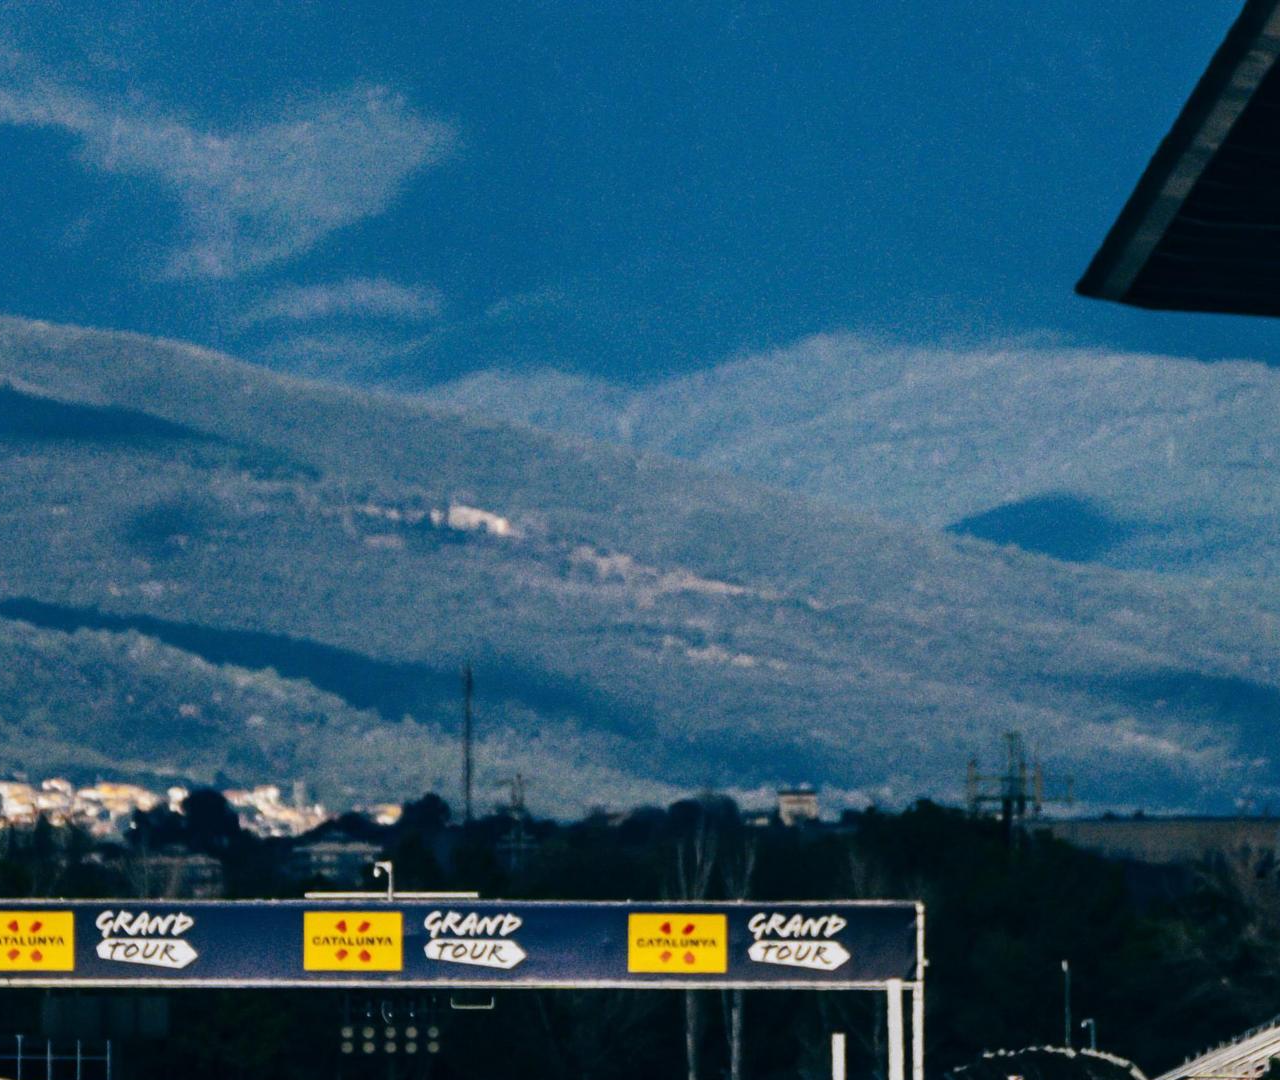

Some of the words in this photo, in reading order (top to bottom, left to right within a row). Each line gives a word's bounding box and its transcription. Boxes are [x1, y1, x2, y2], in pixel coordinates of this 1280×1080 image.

[95, 910, 195, 938] GRAND
[423, 910, 523, 938] GRAND
[747, 912, 848, 940] GRAND
[108, 941, 180, 963] TOUR
[312, 936, 393, 947] CATALUNYA
[435, 941, 509, 963] TOUR
[636, 937, 717, 948] CATALUNYA
[760, 943, 832, 965] TOUR
